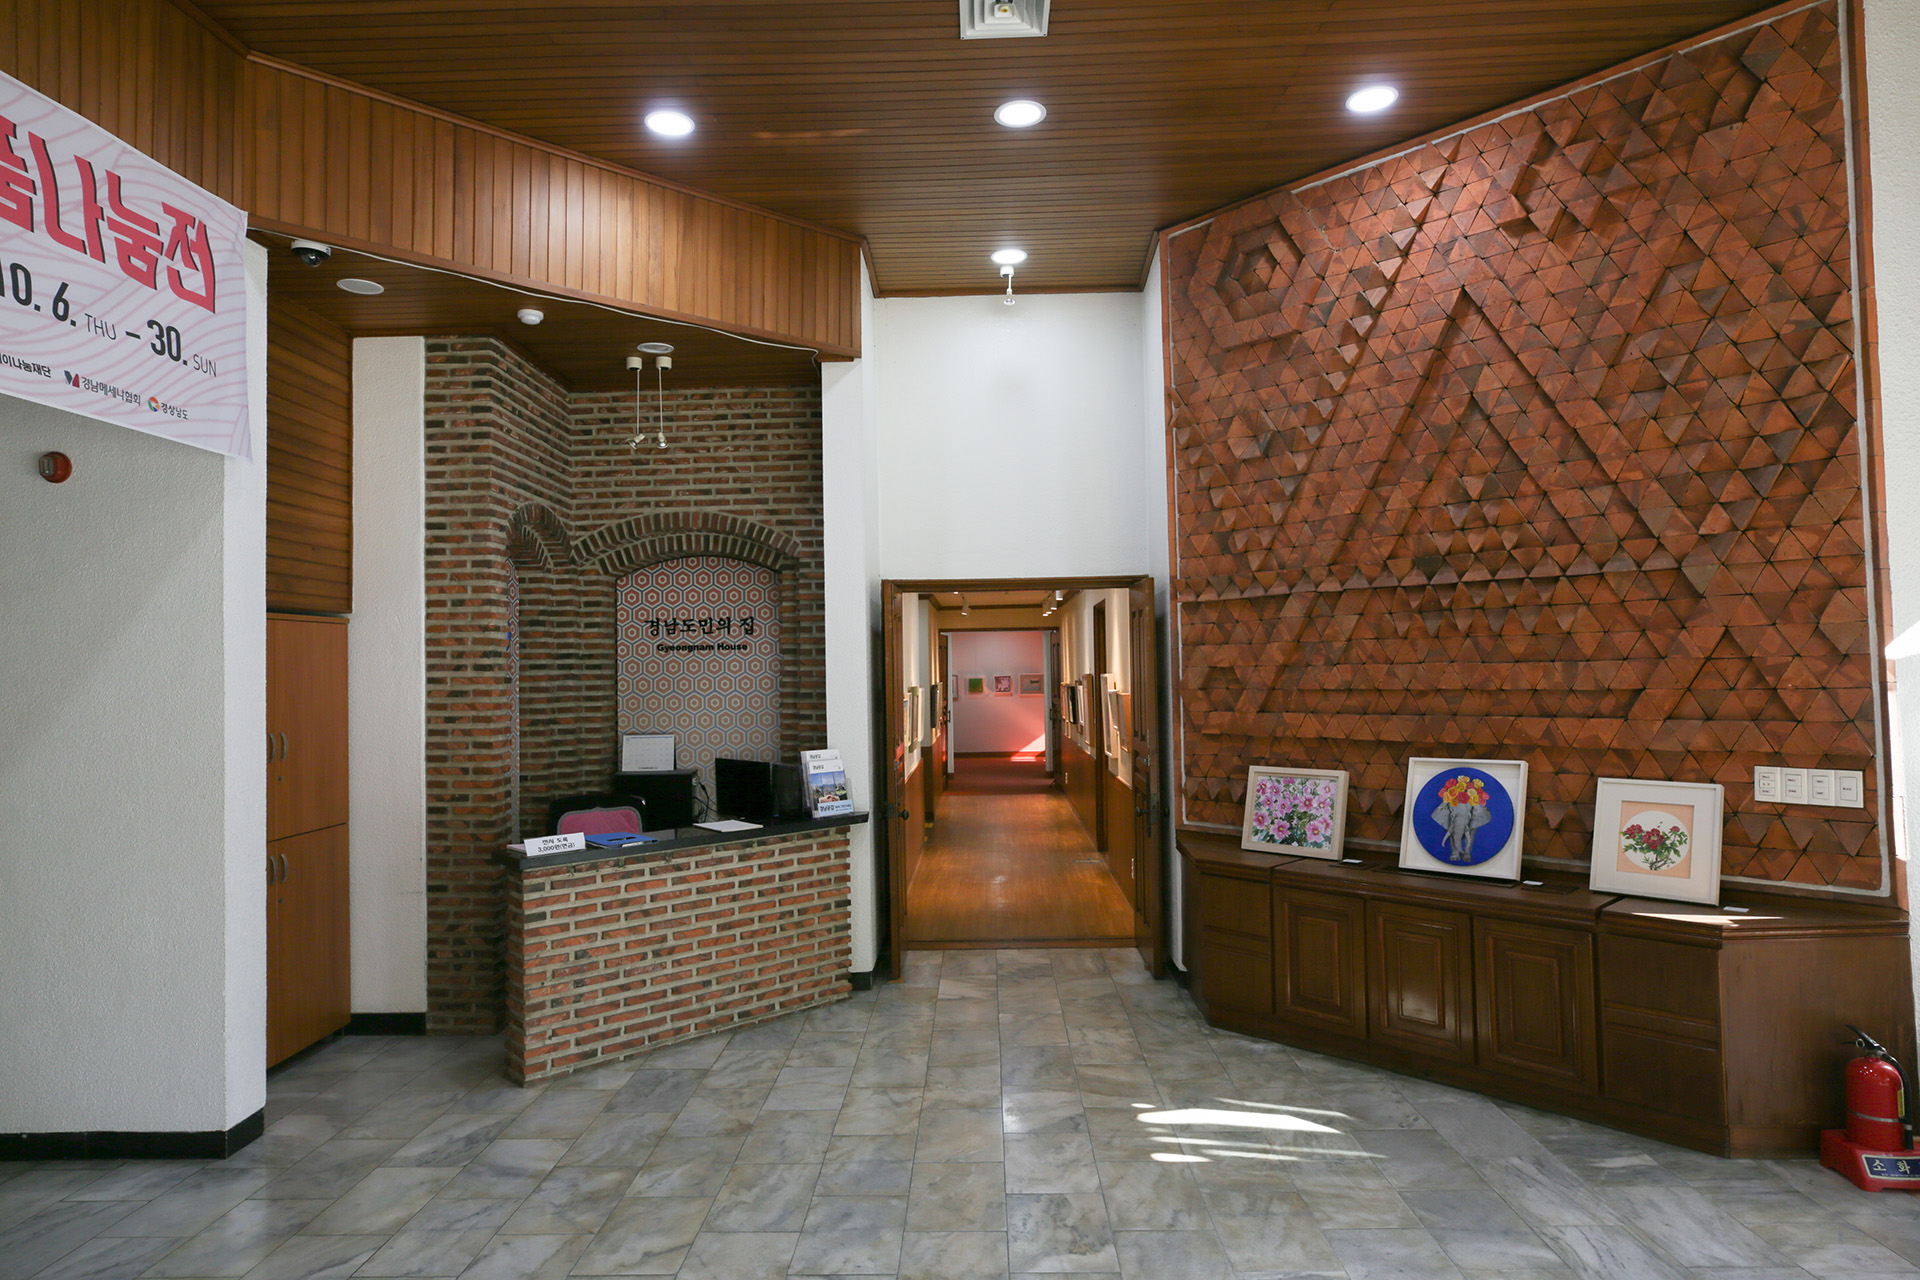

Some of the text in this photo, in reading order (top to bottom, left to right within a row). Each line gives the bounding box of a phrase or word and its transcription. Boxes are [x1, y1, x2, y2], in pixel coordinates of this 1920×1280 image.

[52, 281, 77, 328] 6.
[84, 313, 117, 340] THU
[147, 319, 188, 366] 30.
[192, 353, 217, 378] SUN
[81, 376, 141, 406] 경남메세나협회
[160, 402, 189, 420] 경상남도
[644, 616, 755, 637] 경남도민의 집
[657, 643, 748, 653] Gyeongnam House
[1872, 1158, 1920, 1175] 소화
